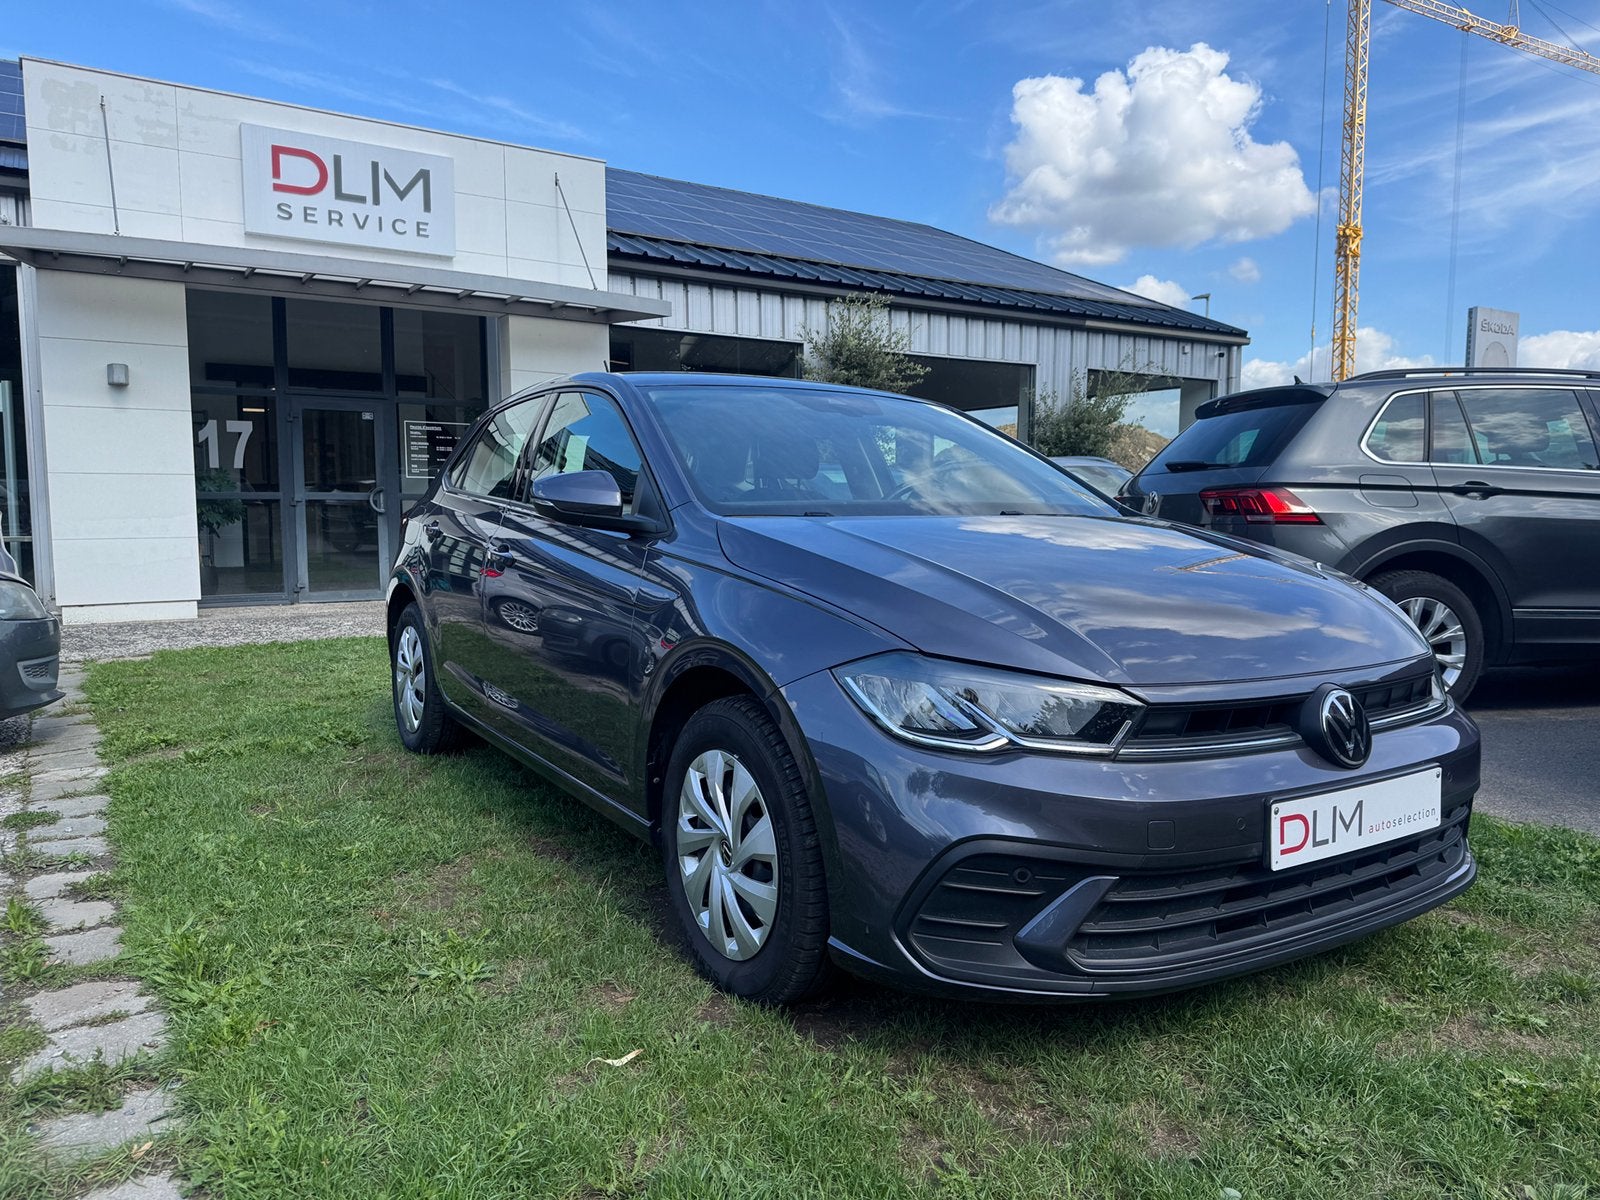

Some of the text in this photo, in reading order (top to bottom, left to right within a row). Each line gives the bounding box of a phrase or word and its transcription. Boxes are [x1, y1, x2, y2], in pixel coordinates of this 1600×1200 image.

[271, 144, 431, 213] DLM
[276, 202, 430, 239] SERVICE
[198, 419, 253, 469] 17
[1279, 799, 1437, 856] DLM autoselection
